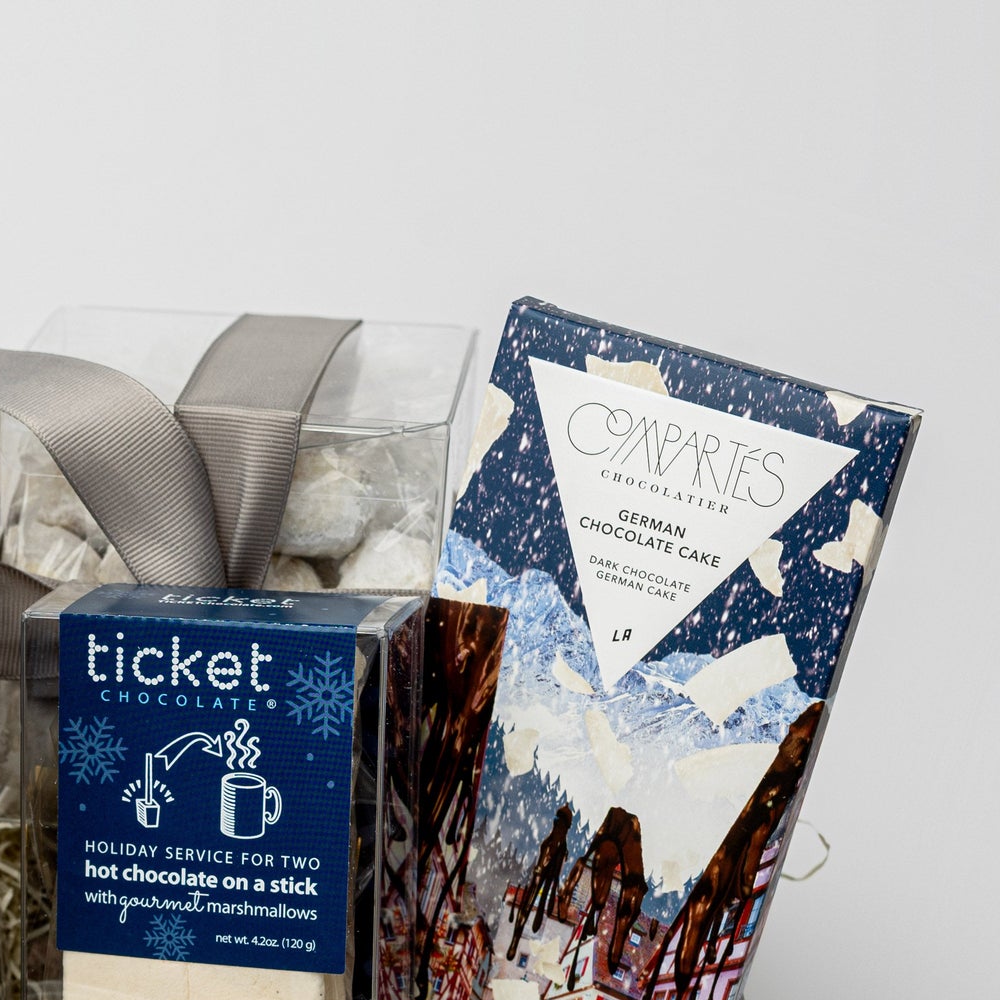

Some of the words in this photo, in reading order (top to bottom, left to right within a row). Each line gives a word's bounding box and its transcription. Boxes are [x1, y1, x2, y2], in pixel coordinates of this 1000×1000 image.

[566, 402, 785, 508] COMPARTÉS
[600, 468, 730, 515] CHOCOLATIER
[618, 509, 687, 539] GERMAN
[579, 516, 674, 554] CHOCOLATE
[678, 546, 721, 568] CAKE
[589, 555, 620, 571] DARK
[622, 565, 691, 593] CHOCOLATE
[596, 570, 644, 591] GERMAN
[647, 585, 677, 602] CAKE
[612, 628, 632, 642] LA
[88, 632, 273, 692] ticket
[85, 839, 158, 858] HOLIDAY
[165, 846, 234, 865] SERVICE
[241, 852, 274, 867] FOR
[281, 855, 320, 870] TWO
[85, 860, 118, 880] hot
[122, 864, 218, 889] chocolate
[222, 875, 249, 891] on
[253, 878, 265, 892] a
[270, 877, 318, 896] stick
[85, 889, 117, 905] with
[119, 890, 209, 924] gourmet
[207, 901, 318, 921] marshmallows
[215, 933, 232, 944] net
[234, 934, 250, 945] wt.
[251, 936, 280, 947] 4.2oz.
[281, 937, 303, 950] (120
[305, 940, 316, 952] g)
